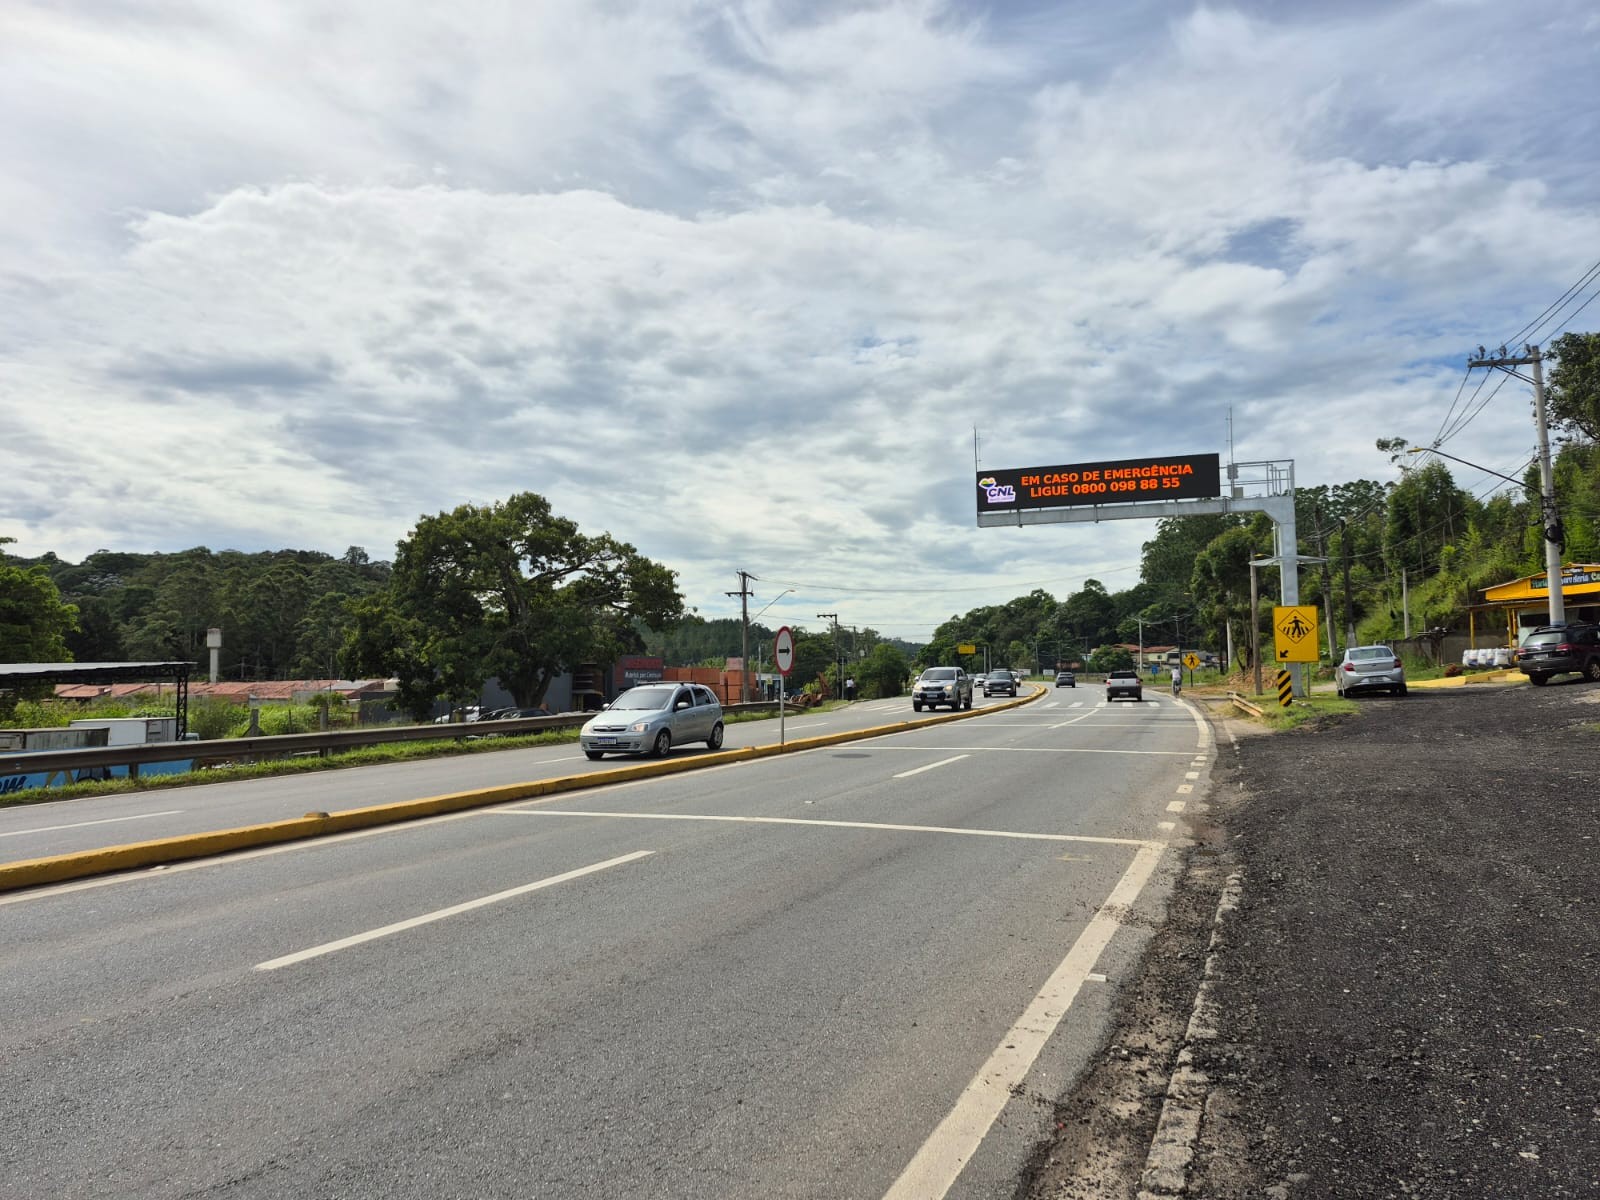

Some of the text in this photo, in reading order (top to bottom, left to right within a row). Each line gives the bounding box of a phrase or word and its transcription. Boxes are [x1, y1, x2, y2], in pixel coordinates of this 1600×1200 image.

[1021, 464, 1193, 486] EM CASO DE EMERGÊNCIA
[988, 486, 1015, 497] CNL
[1030, 477, 1180, 498] LIGUE 0800 098 88 55
